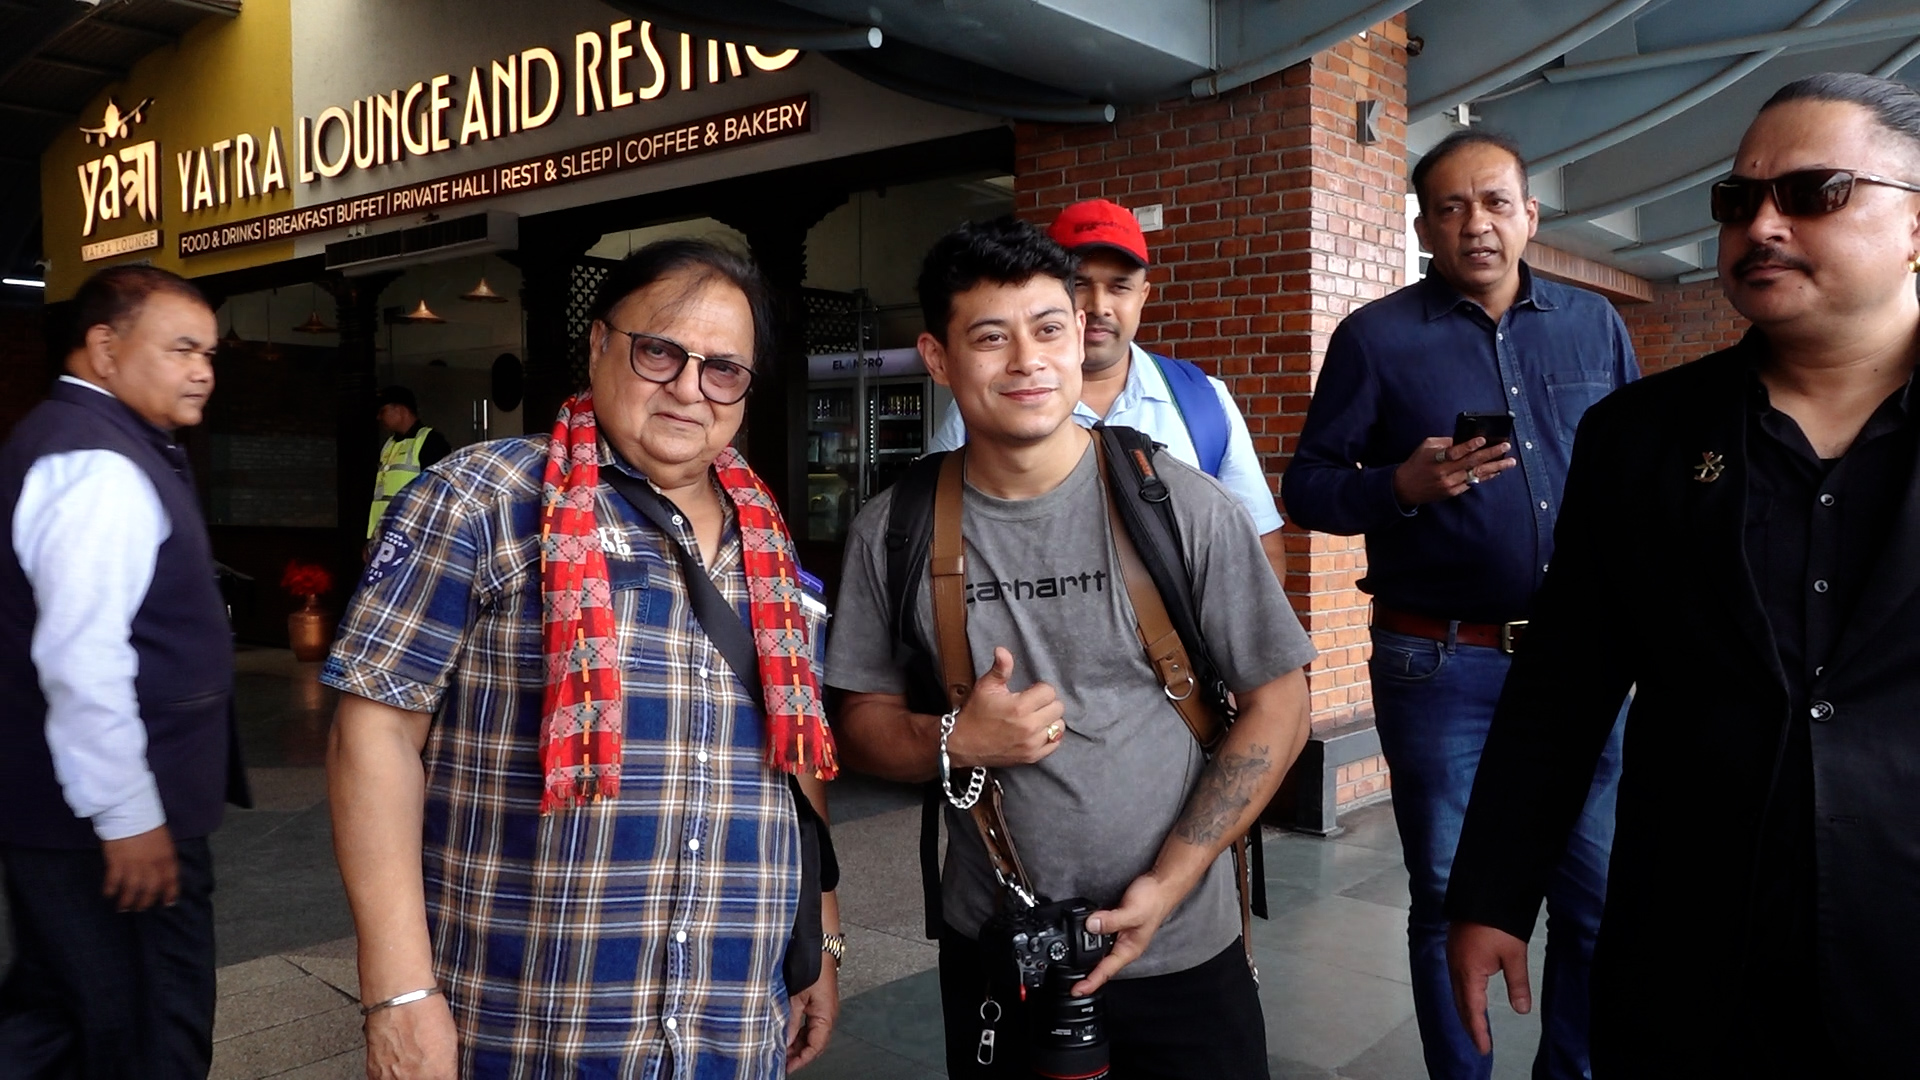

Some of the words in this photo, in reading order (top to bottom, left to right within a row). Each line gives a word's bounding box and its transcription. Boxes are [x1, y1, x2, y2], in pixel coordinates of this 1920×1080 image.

[177, 126, 286, 213] YATRA
[299, 74, 451, 184] LOUNGE
[459, 46, 560, 146] AND
[181, 232, 211, 254] FOOD
[212, 230, 220, 248] &
[221, 222, 262, 247] DRINKS
[268, 206, 336, 238] BREAKFAST
[336, 195, 385, 224] BUFFET
[393, 181, 449, 212] PRIVATE
[451, 173, 491, 200] HALL
[501, 162, 542, 190] REST
[544, 159, 557, 181] &
[560, 145, 613, 178] SLEEP
[624, 125, 700, 164] COFFEE
[703, 121, 719, 147] &
[724, 100, 808, 142] BAKERY
[83, 242, 111, 259] YATRA
[116, 232, 156, 252] LOUNGE
